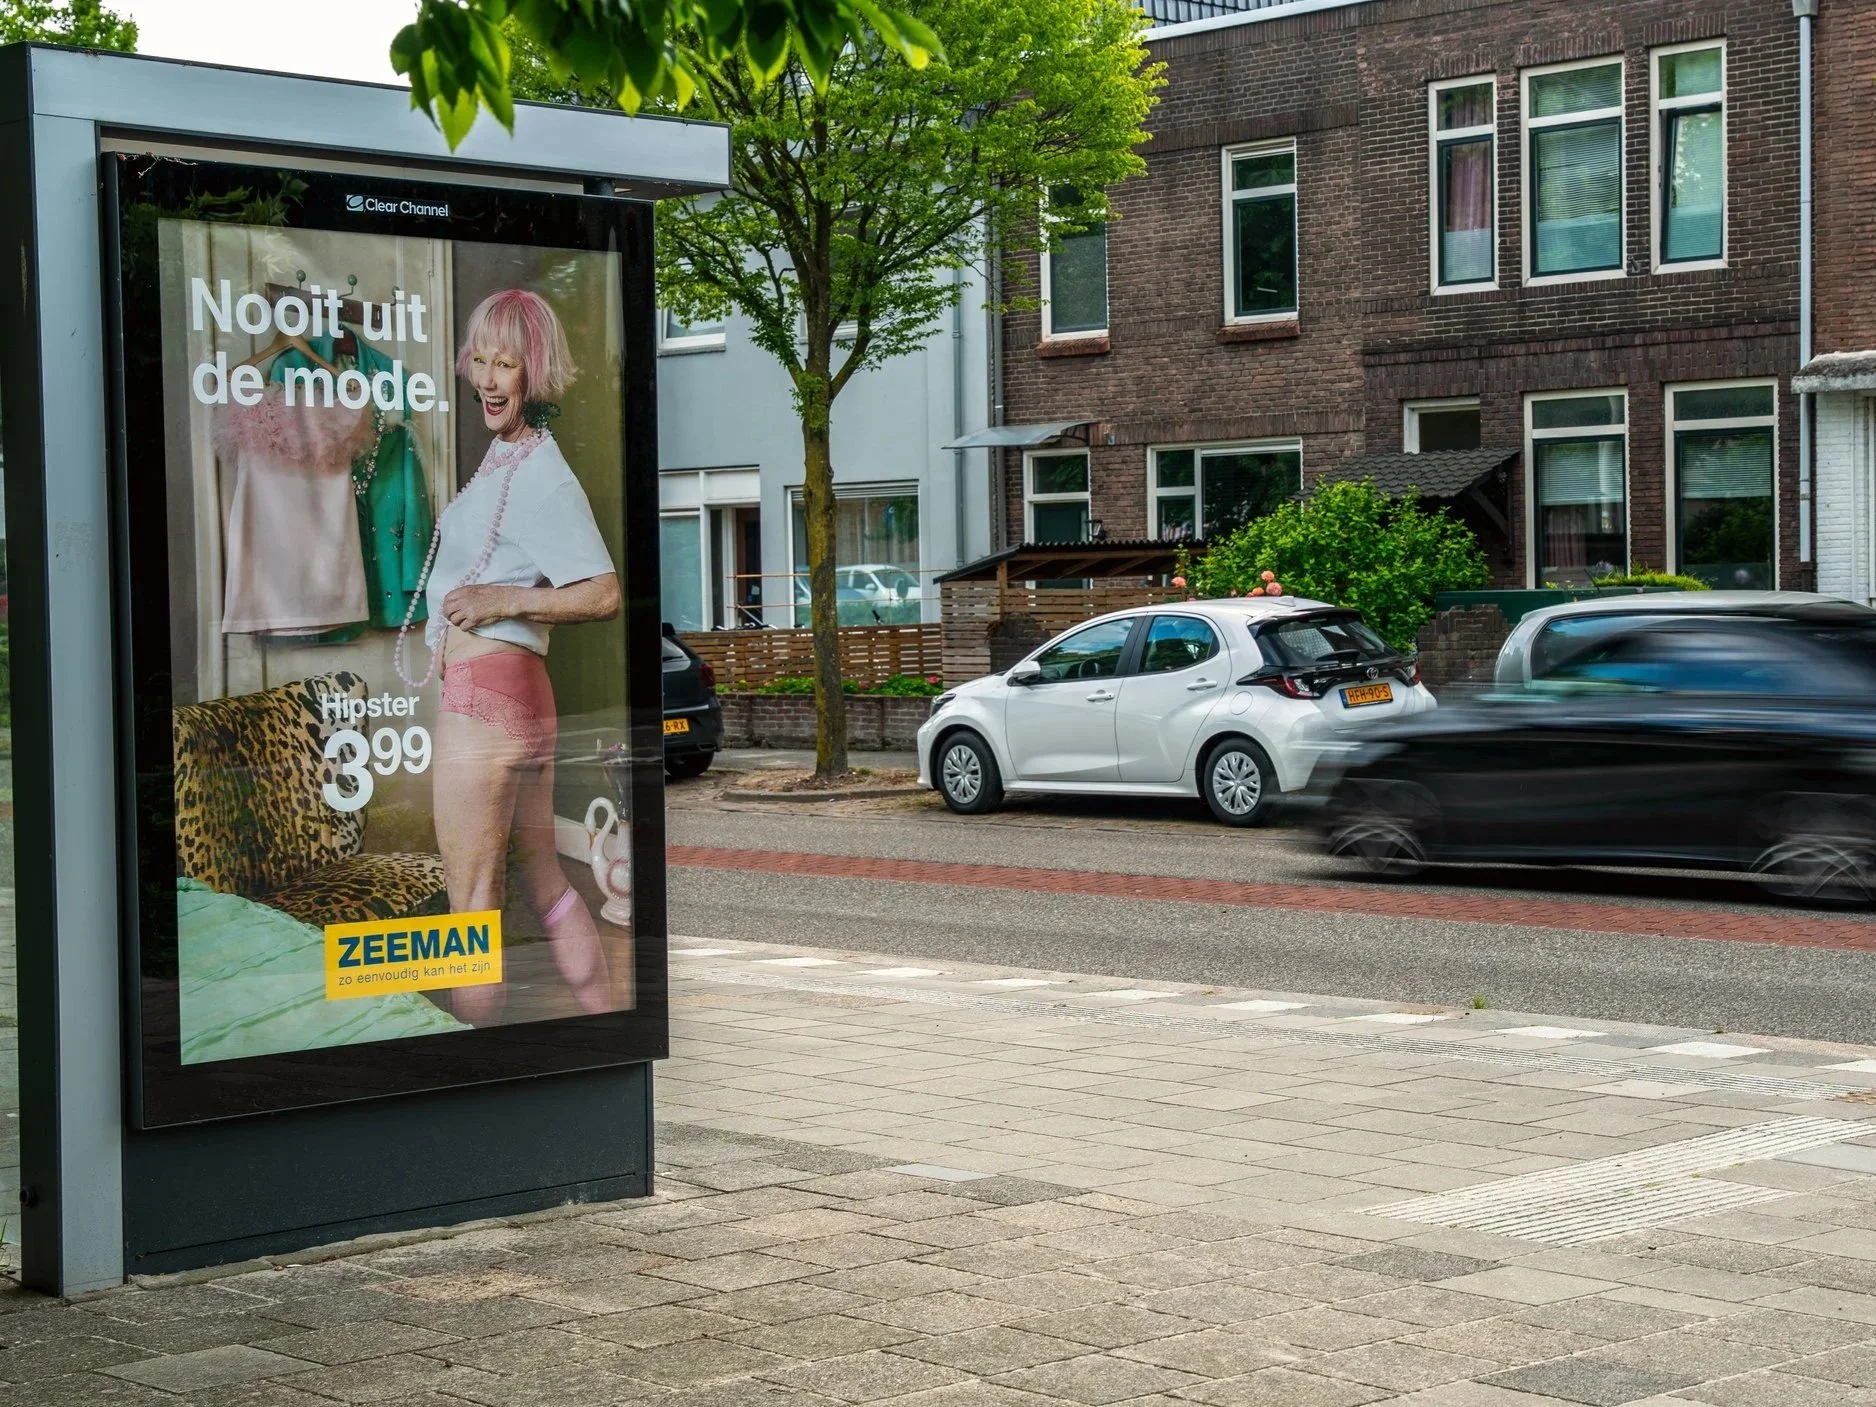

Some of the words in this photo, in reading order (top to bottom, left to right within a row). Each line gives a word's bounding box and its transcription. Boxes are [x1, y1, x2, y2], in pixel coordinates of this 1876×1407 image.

[365, 198, 398, 213] Clear
[400, 201, 449, 217] Channel
[191, 277, 344, 338] Nooit
[362, 290, 428, 343] uit
[192, 351, 265, 406] de
[285, 359, 450, 413] mode.
[1348, 686, 1389, 702] HFH-90-S
[321, 693, 420, 724] Hipster
[663, 719, 686, 732] 6-RX
[338, 924, 490, 969] ZEEMAN
[338, 975, 353, 986] zo
[357, 968, 419, 984] eenvoudig
[424, 965, 445, 977] kan
[450, 961, 467, 974] het
[472, 960, 491, 973] zijn
